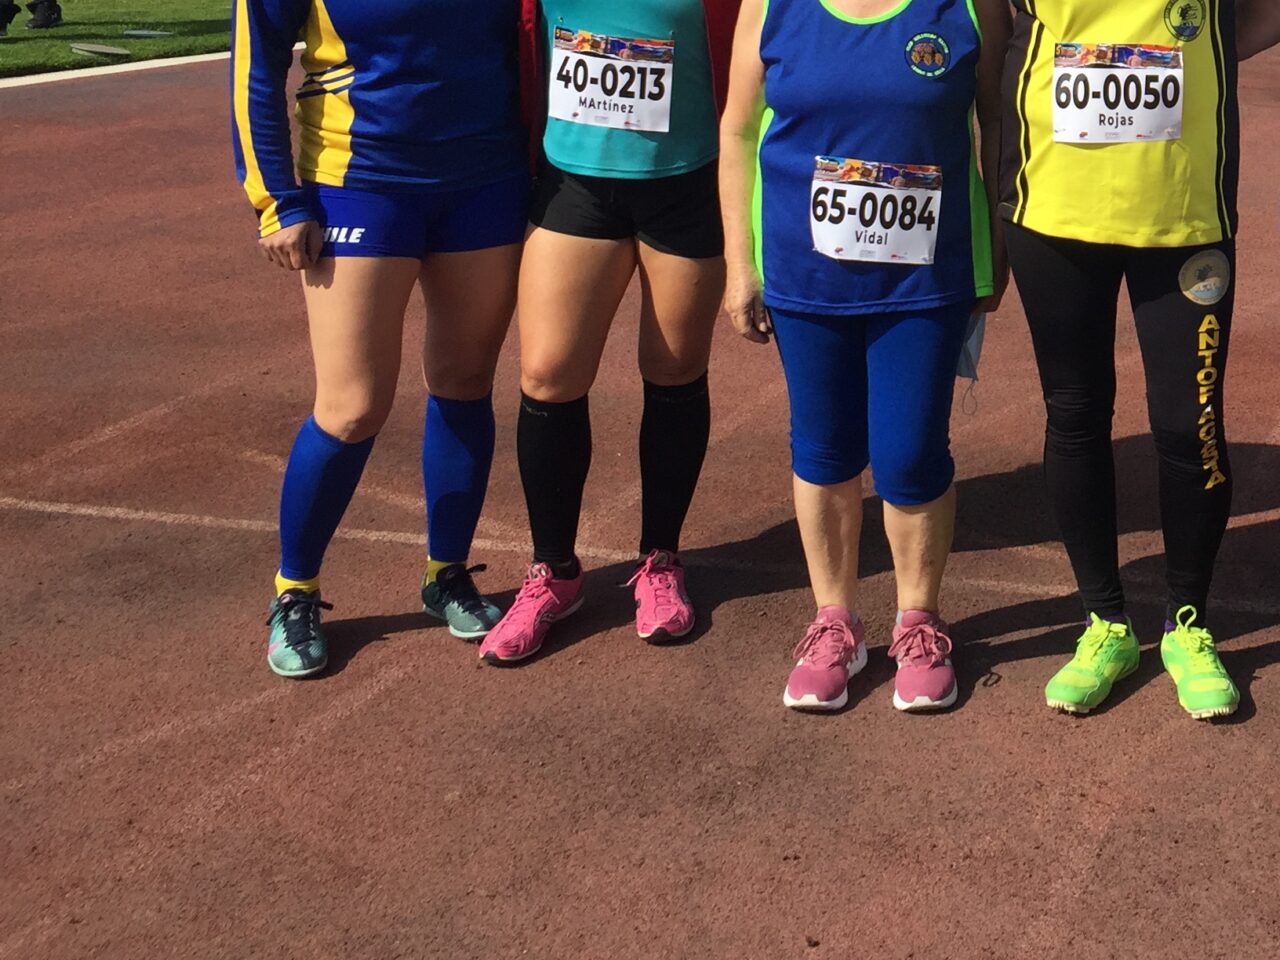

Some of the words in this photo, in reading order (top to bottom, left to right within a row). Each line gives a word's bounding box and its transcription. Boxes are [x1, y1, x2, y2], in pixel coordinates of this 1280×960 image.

[556, 55, 666, 102] 40-0213
[1054, 72, 1181, 111] 60-0050
[1098, 112, 1135, 130] Rojas
[811, 186, 936, 232] 65-0084
[854, 229, 889, 246] Vidal
